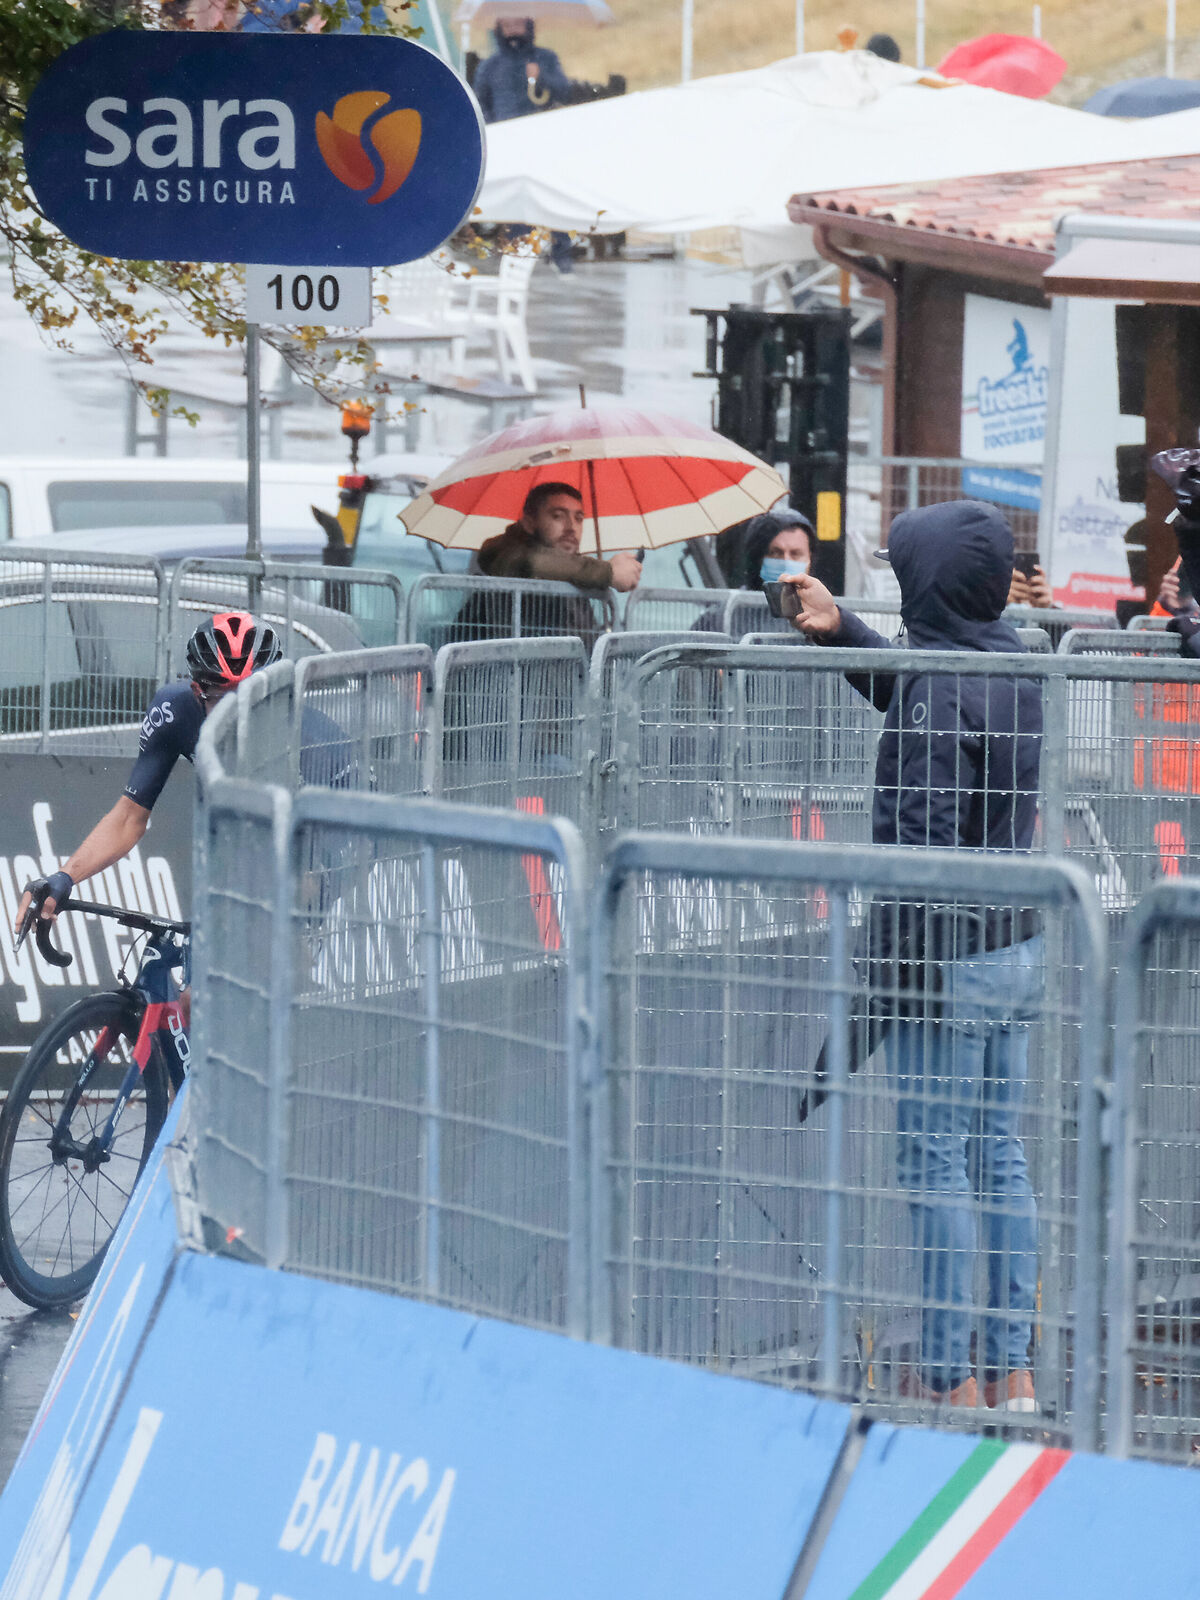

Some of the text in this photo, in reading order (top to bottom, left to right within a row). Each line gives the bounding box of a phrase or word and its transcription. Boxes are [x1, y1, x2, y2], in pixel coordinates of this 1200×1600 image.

[84, 96, 296, 170] sara
[85, 178, 296, 204] TI ASSICURA
[266, 273, 340, 313] 100
[277, 1431, 457, 1595] BANCA
